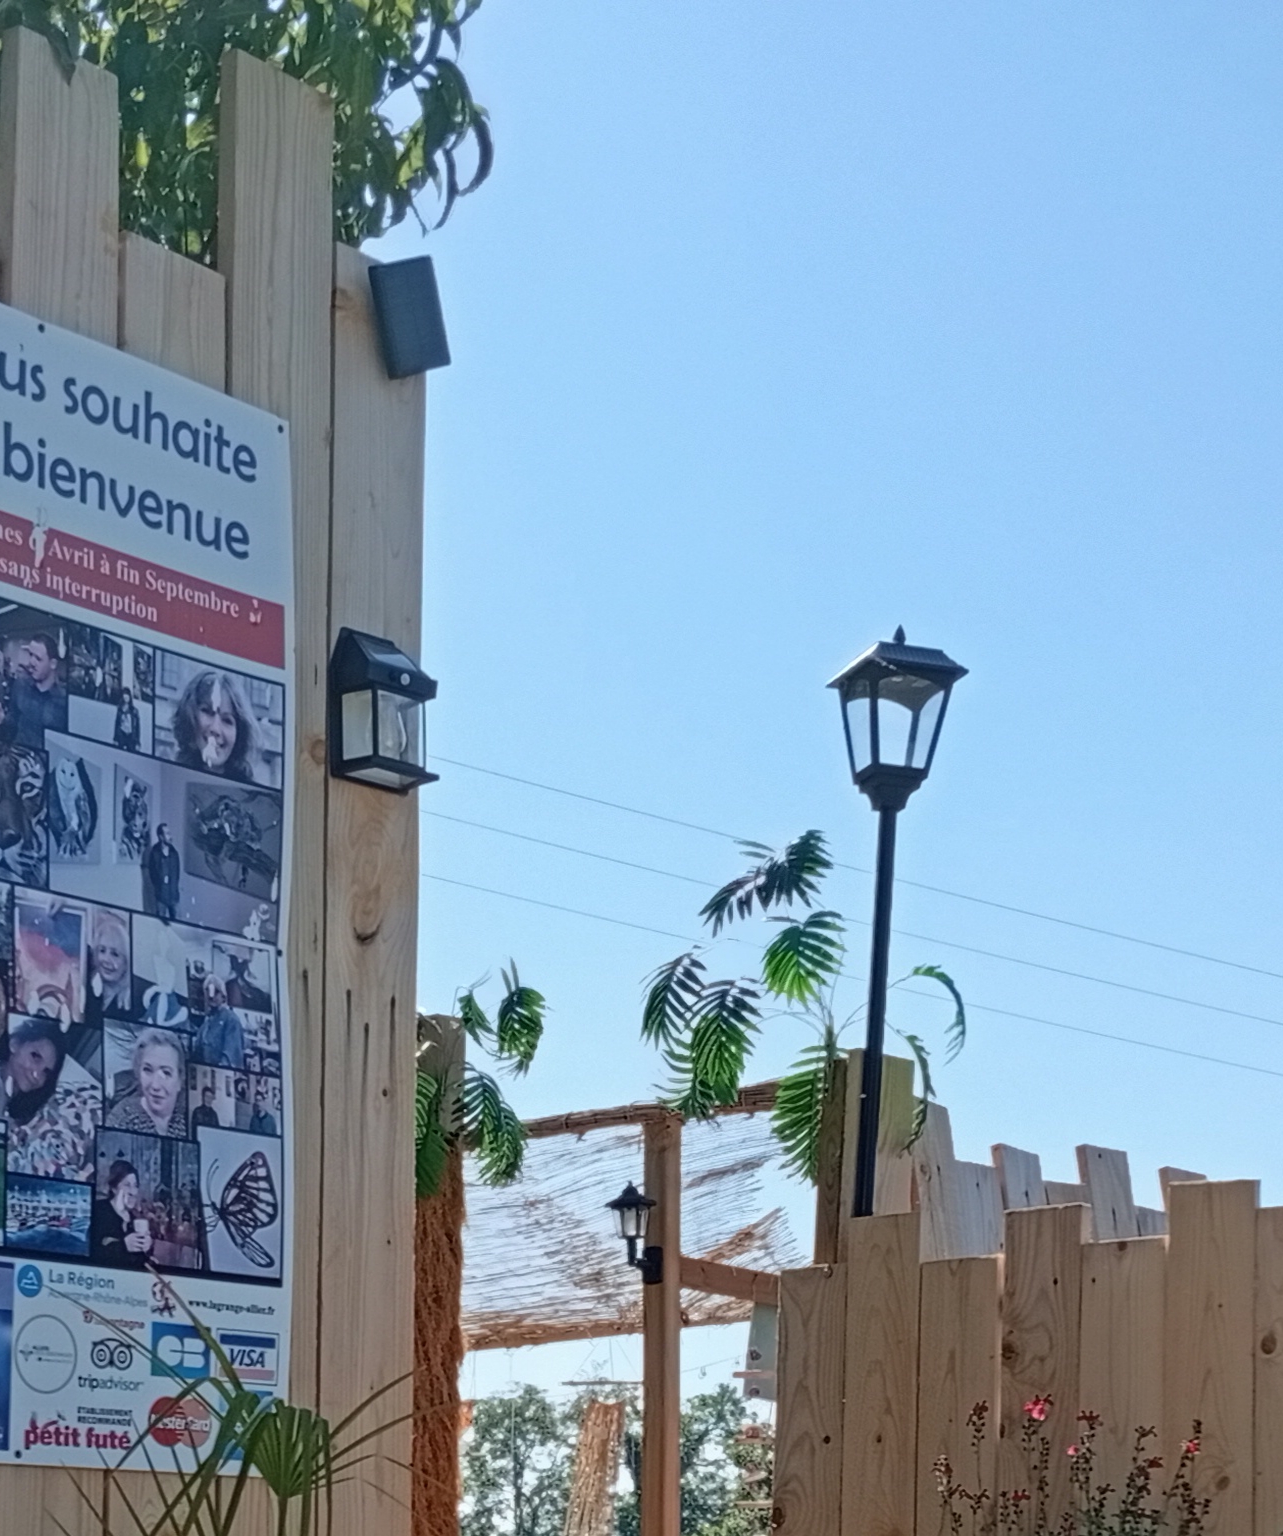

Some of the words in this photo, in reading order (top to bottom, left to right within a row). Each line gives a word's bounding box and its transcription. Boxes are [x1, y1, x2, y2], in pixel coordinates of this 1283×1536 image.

[63, 376, 257, 483] souhaite
[3, 420, 250, 561] bienvenue
[45, 566, 158, 623] interruption
[99, 553, 110, 576] à
[116, 559, 140, 585] fin
[145, 568, 240, 618] Septembre
[48, 1268, 65, 1284] La
[67, 1271, 115, 1290] Région
[157, 1335, 206, 1369] CB
[228, 1348, 266, 1368] VISA
[78, 1374, 140, 1392] tripadvisor
[86, 1427, 131, 1450] futé
